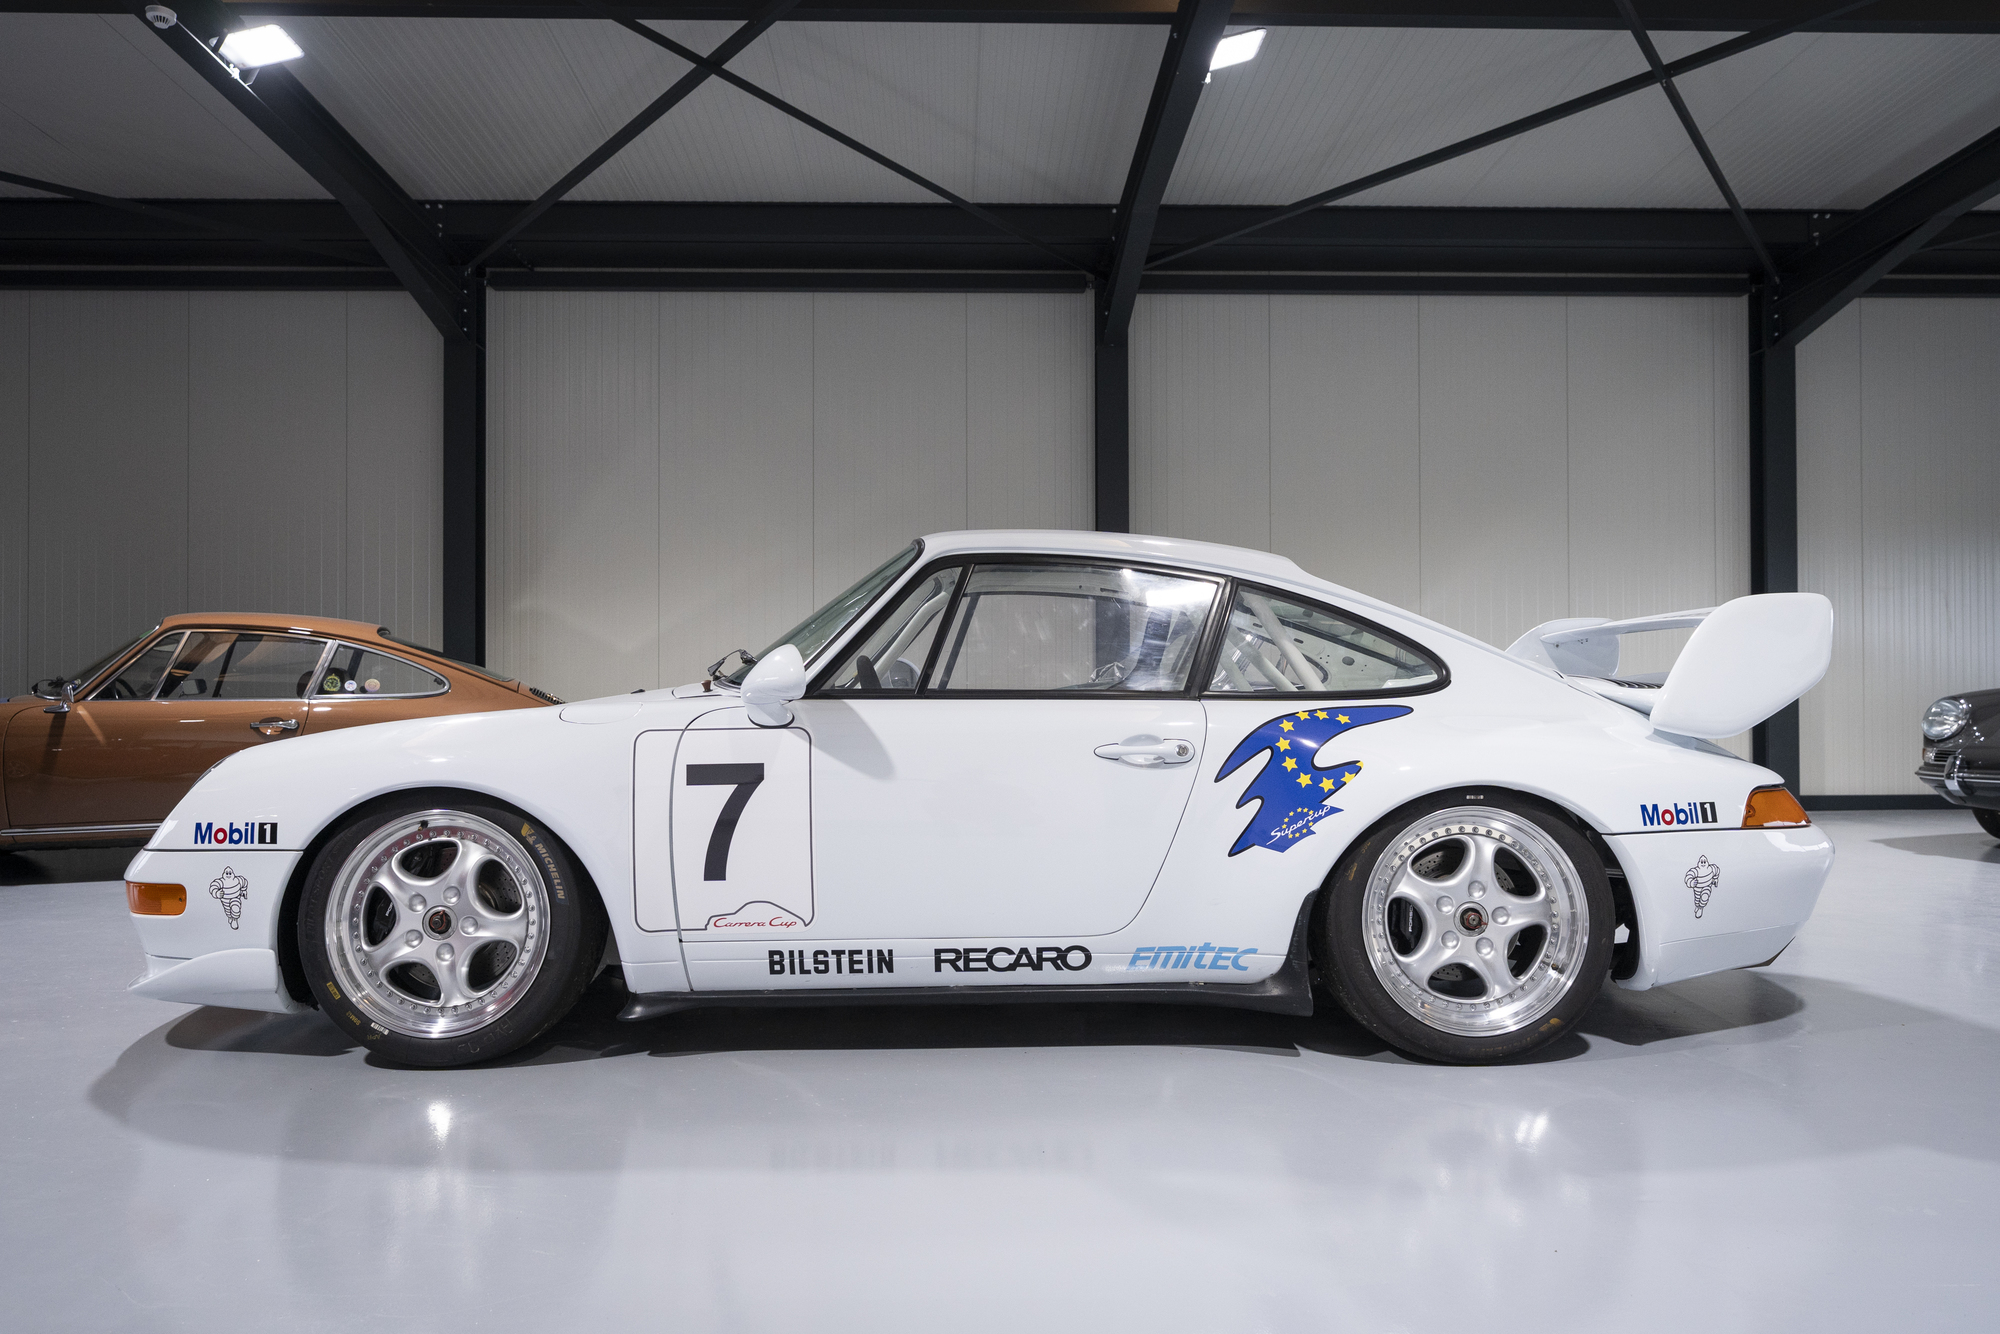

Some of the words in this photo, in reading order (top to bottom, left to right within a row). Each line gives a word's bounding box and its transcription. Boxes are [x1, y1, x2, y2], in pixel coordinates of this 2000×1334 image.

[685, 763, 765, 882] 7
[1266, 805, 1331, 845] Supercup
[1640, 802, 1700, 826] Mobil
[194, 822, 255, 845] Mobil
[534, 843, 566, 900] MICHELIN
[713, 917, 766, 928] Carrera
[769, 916, 797, 929] Cup
[768, 949, 895, 975] BILSTEIN
[934, 945, 1093, 972] RECARO
